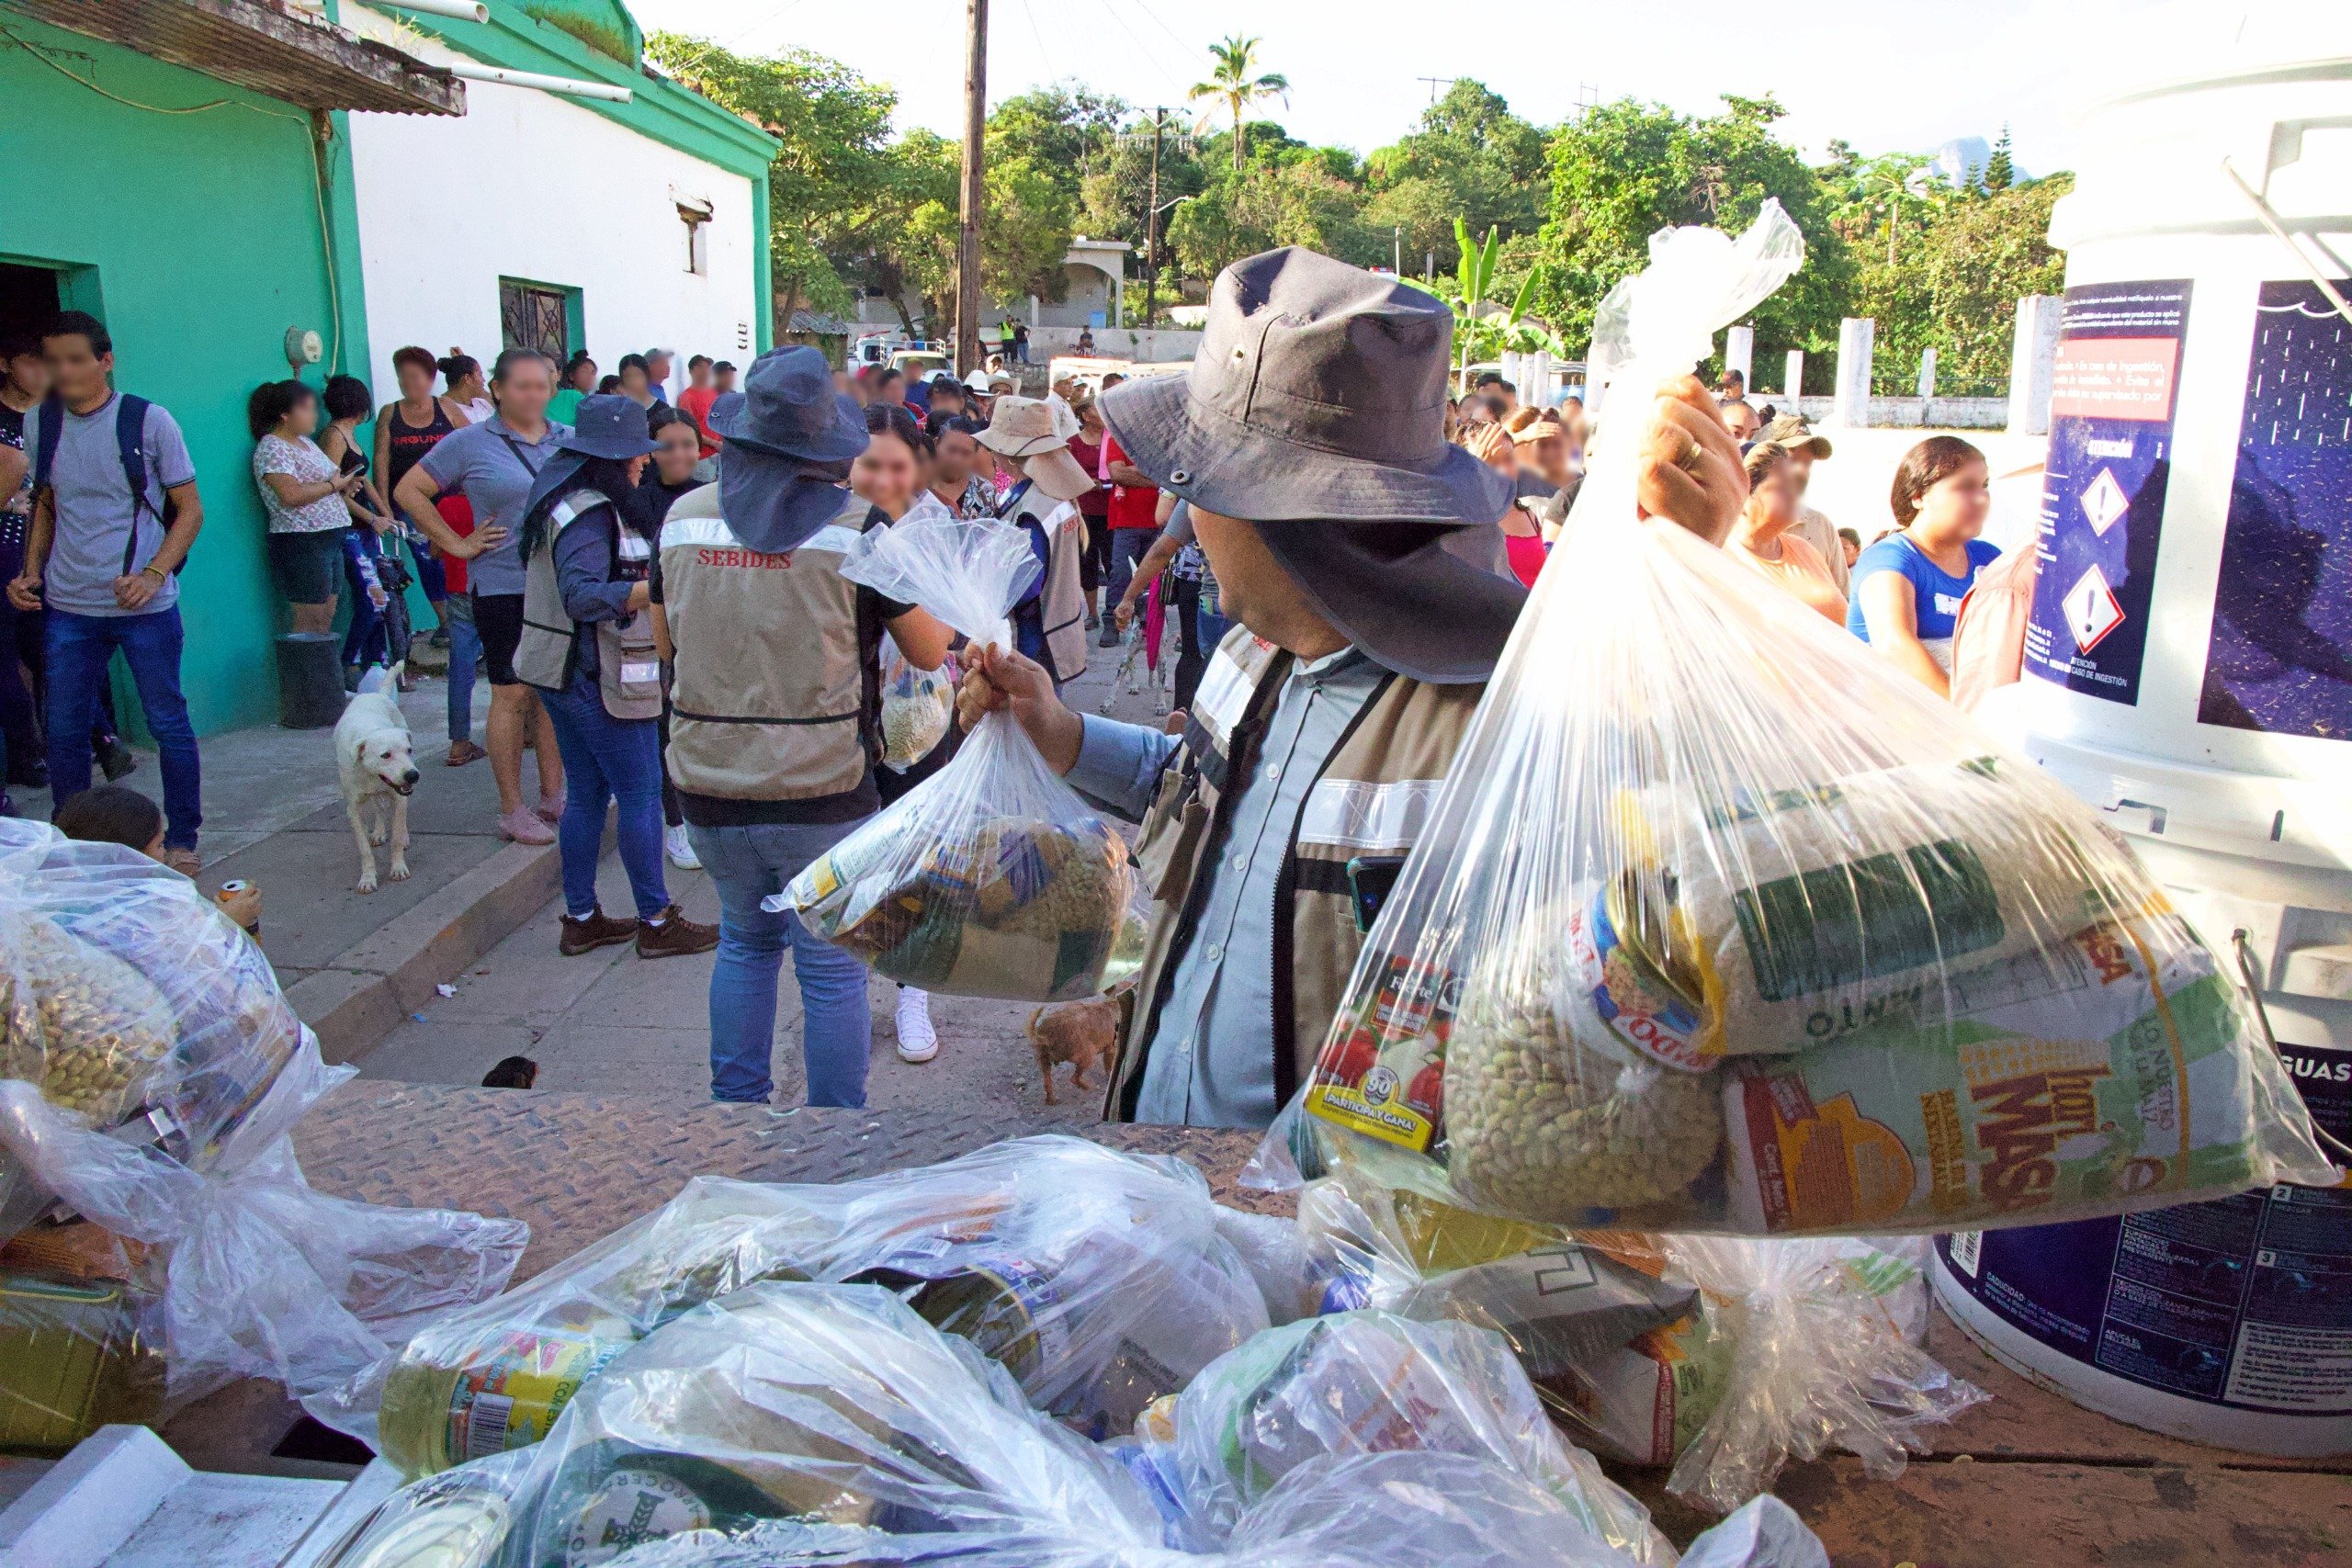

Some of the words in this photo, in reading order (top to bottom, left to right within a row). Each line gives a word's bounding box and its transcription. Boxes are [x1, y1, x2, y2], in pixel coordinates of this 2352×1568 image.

[2131, 309, 2154, 319] producto
[697, 548, 791, 570] SEBIDES
[2070, 656, 2098, 671] ATENCIÓN
[2071, 666, 2086, 678] CASO
[2086, 669, 2095, 680] DE
[2094, 671, 2129, 687] INGESTIÓN
[1365, 1075, 1392, 1095] 90
[1384, 1111, 1417, 1133] GANA!
